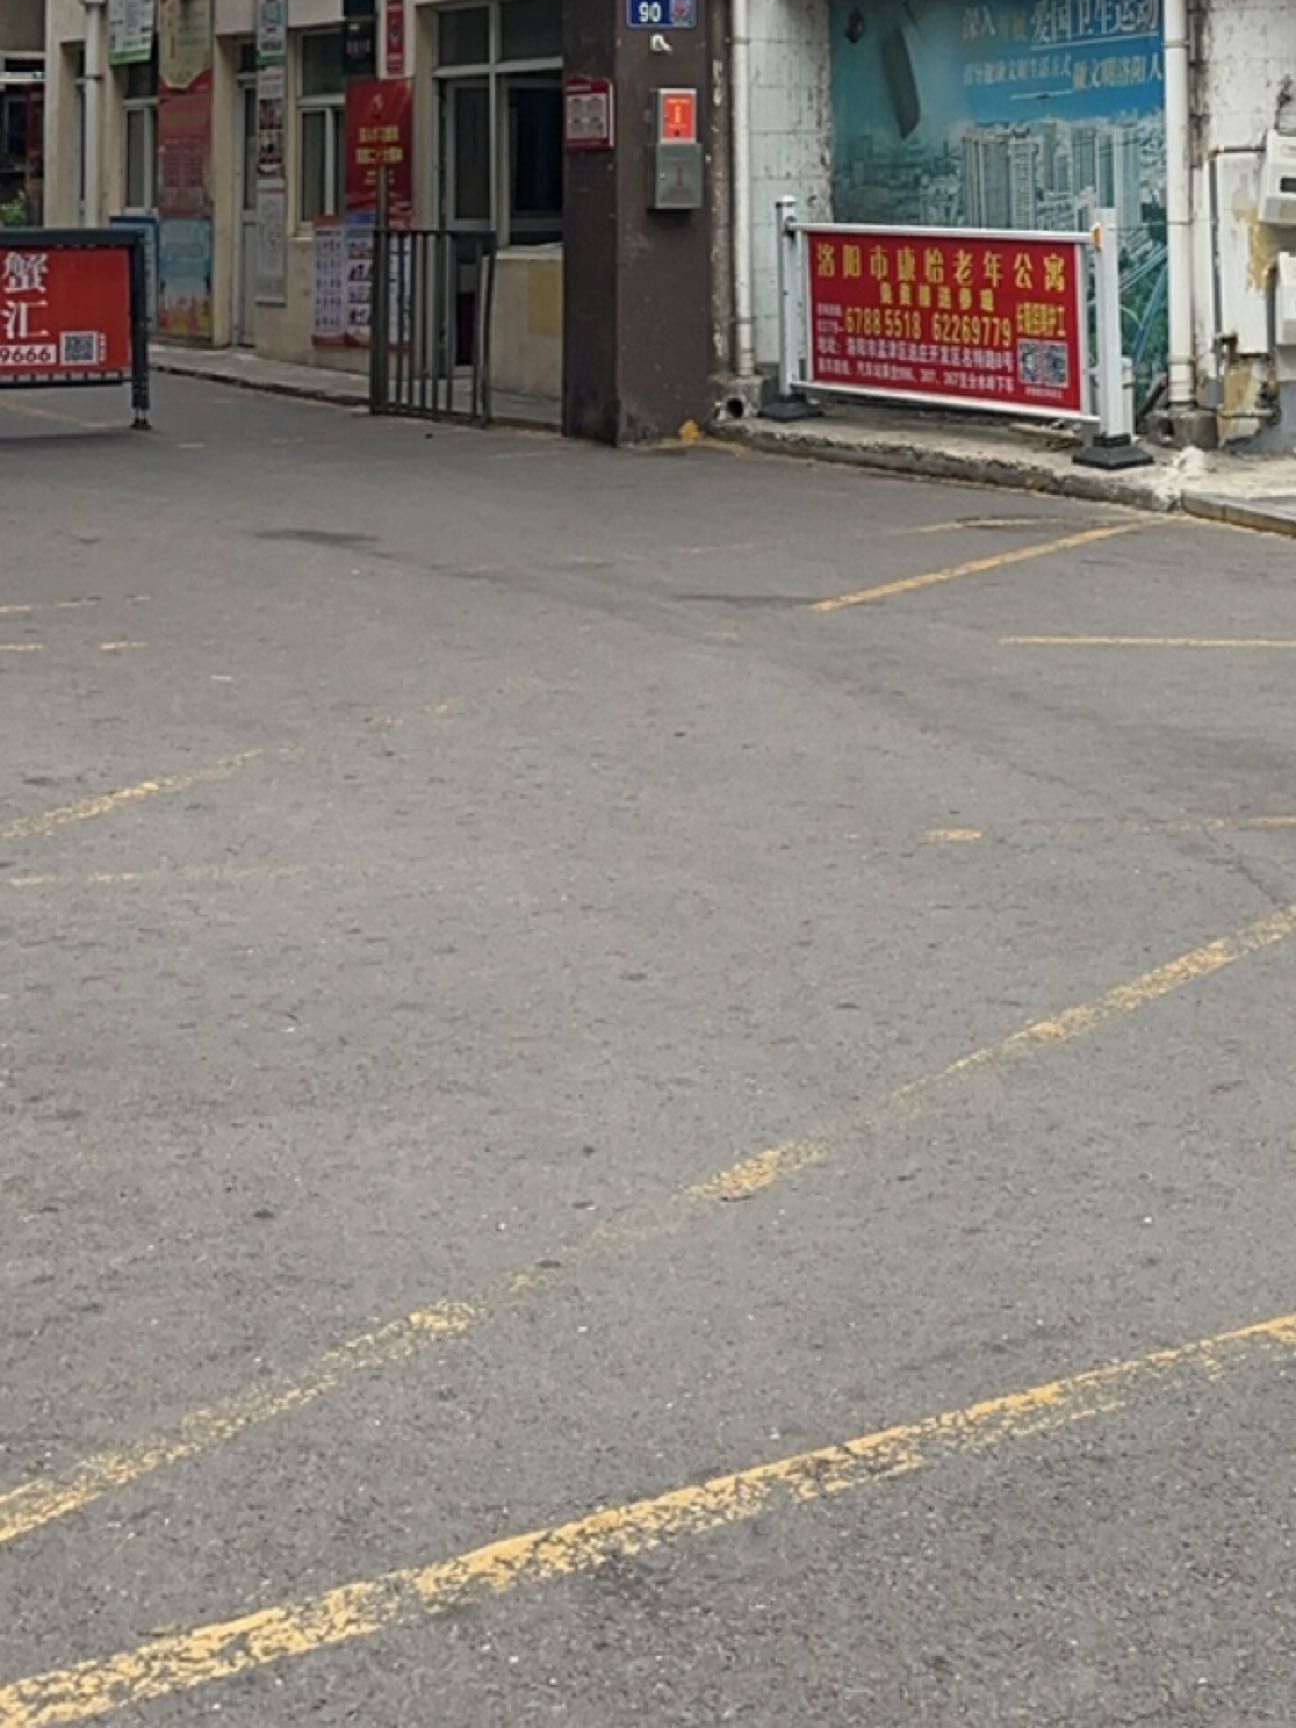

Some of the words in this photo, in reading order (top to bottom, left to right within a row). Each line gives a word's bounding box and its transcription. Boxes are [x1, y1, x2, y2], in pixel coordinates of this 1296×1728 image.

[639, 1, 662, 23] 90
[1, 251, 49, 294] 蟹
[817, 242, 1066, 293] 洛阳市康怡老年公寓
[0, 300, 50, 340] 汇
[931, 311, 1011, 347] 62269779
